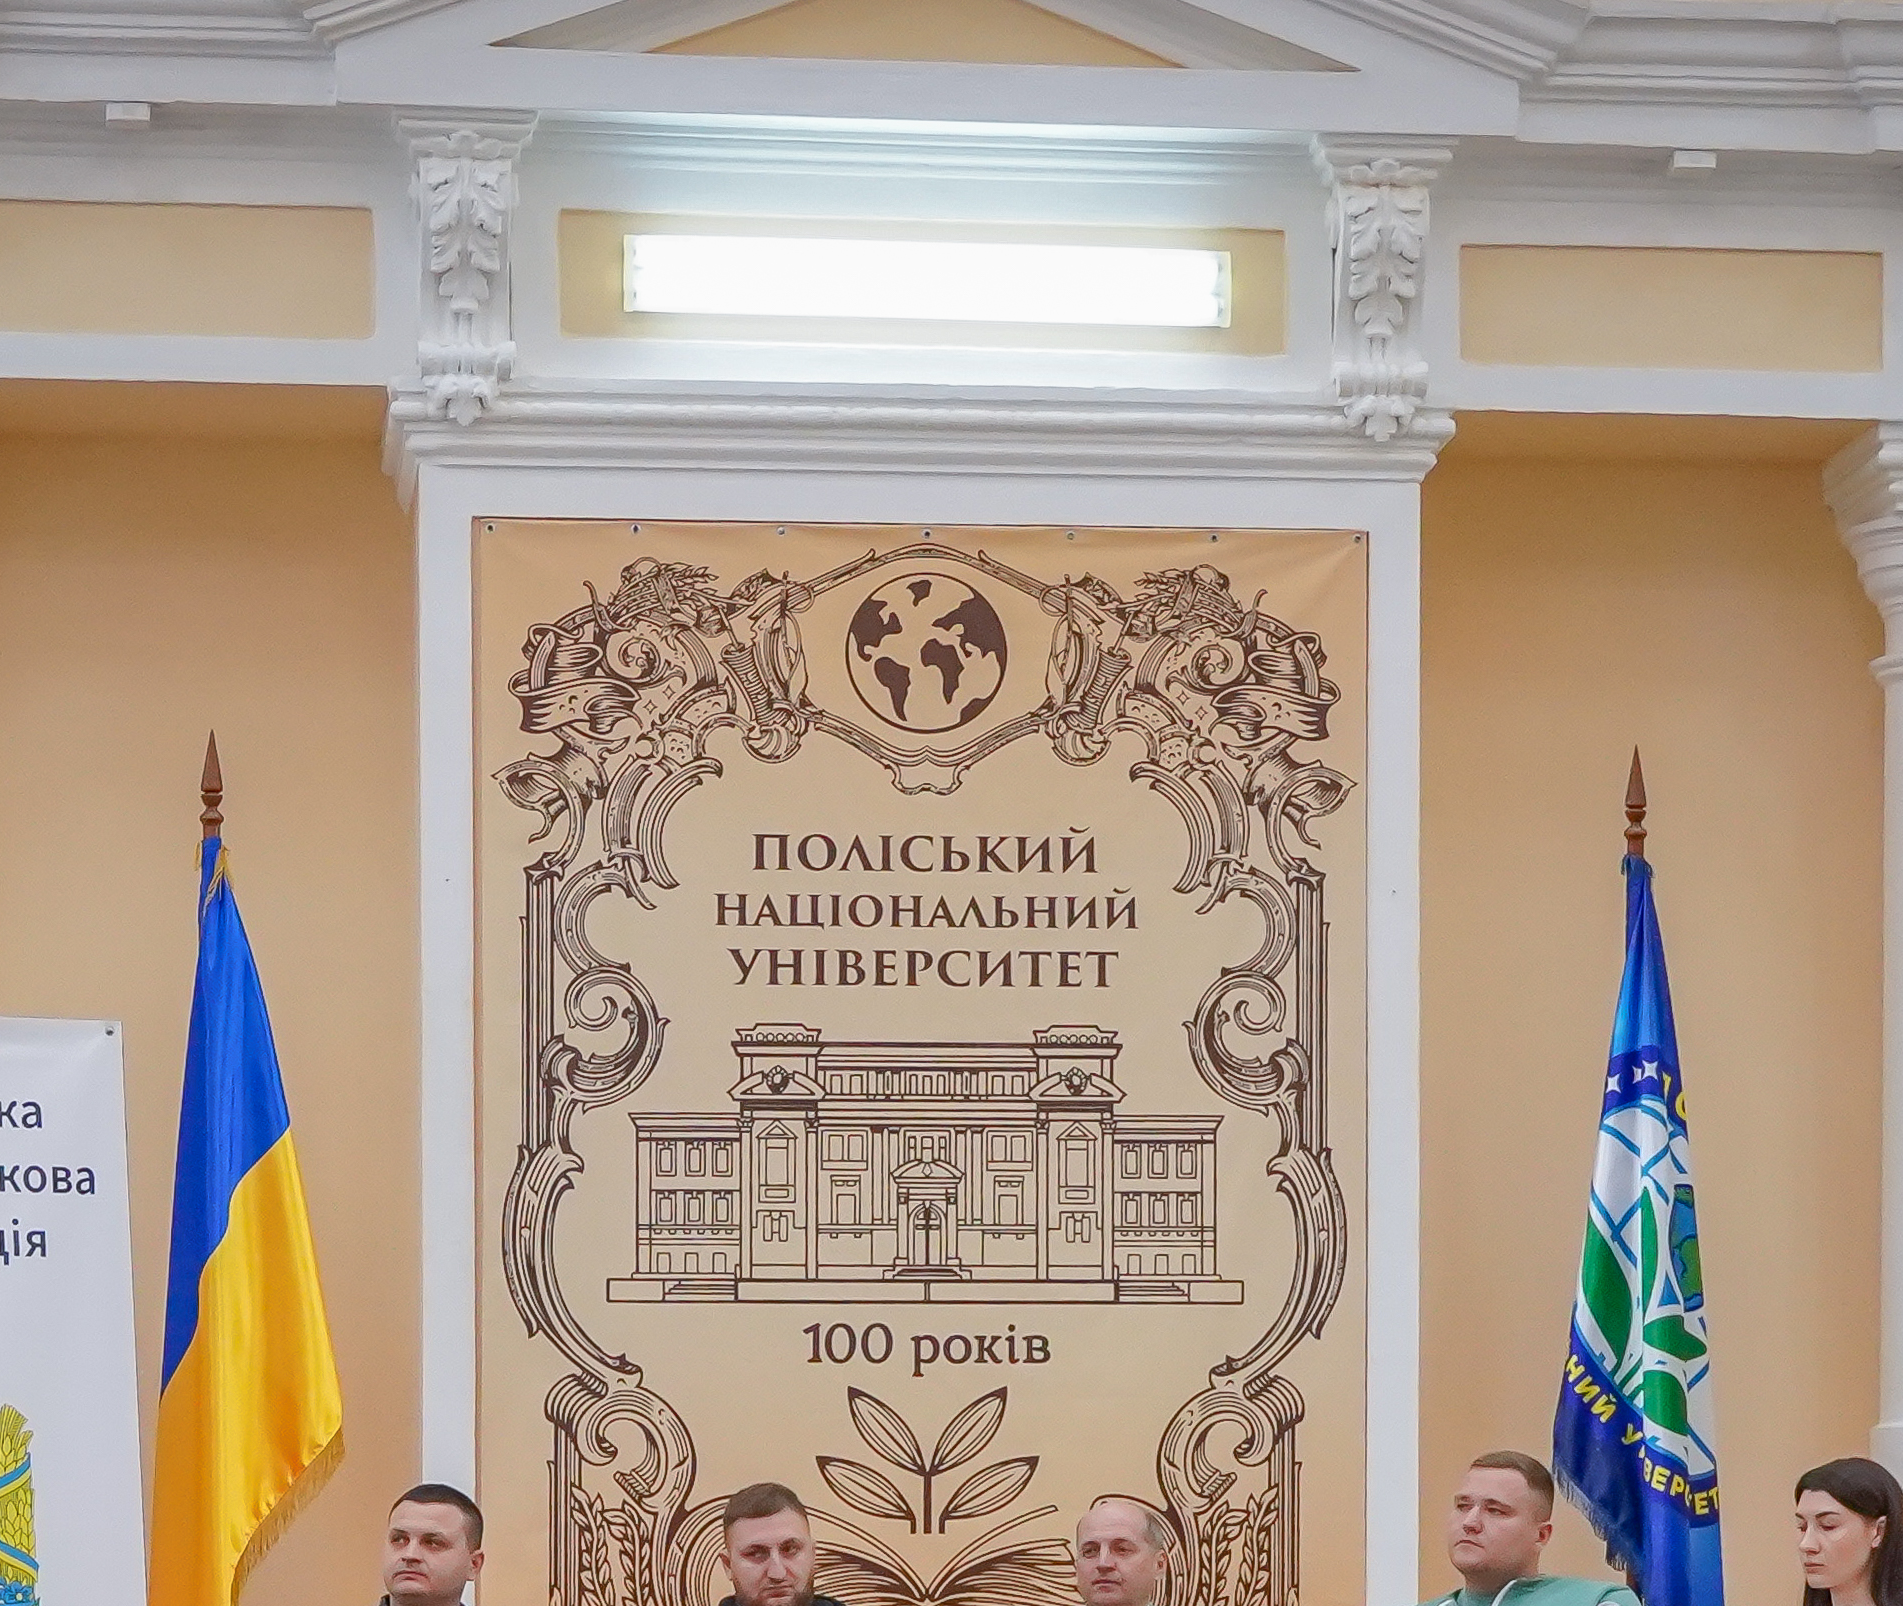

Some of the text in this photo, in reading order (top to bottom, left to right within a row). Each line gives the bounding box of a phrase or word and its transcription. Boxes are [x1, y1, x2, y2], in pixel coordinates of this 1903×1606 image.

[753, 826, 1098, 873] ПОЛІСЬКИЙ
[715, 888, 1138, 929] НАЦІОНАЛЬНИЙ
[727, 949, 1118, 987] УНІВЕРСИТЕТ
[803, 1323, 1050, 1377] 100 років
